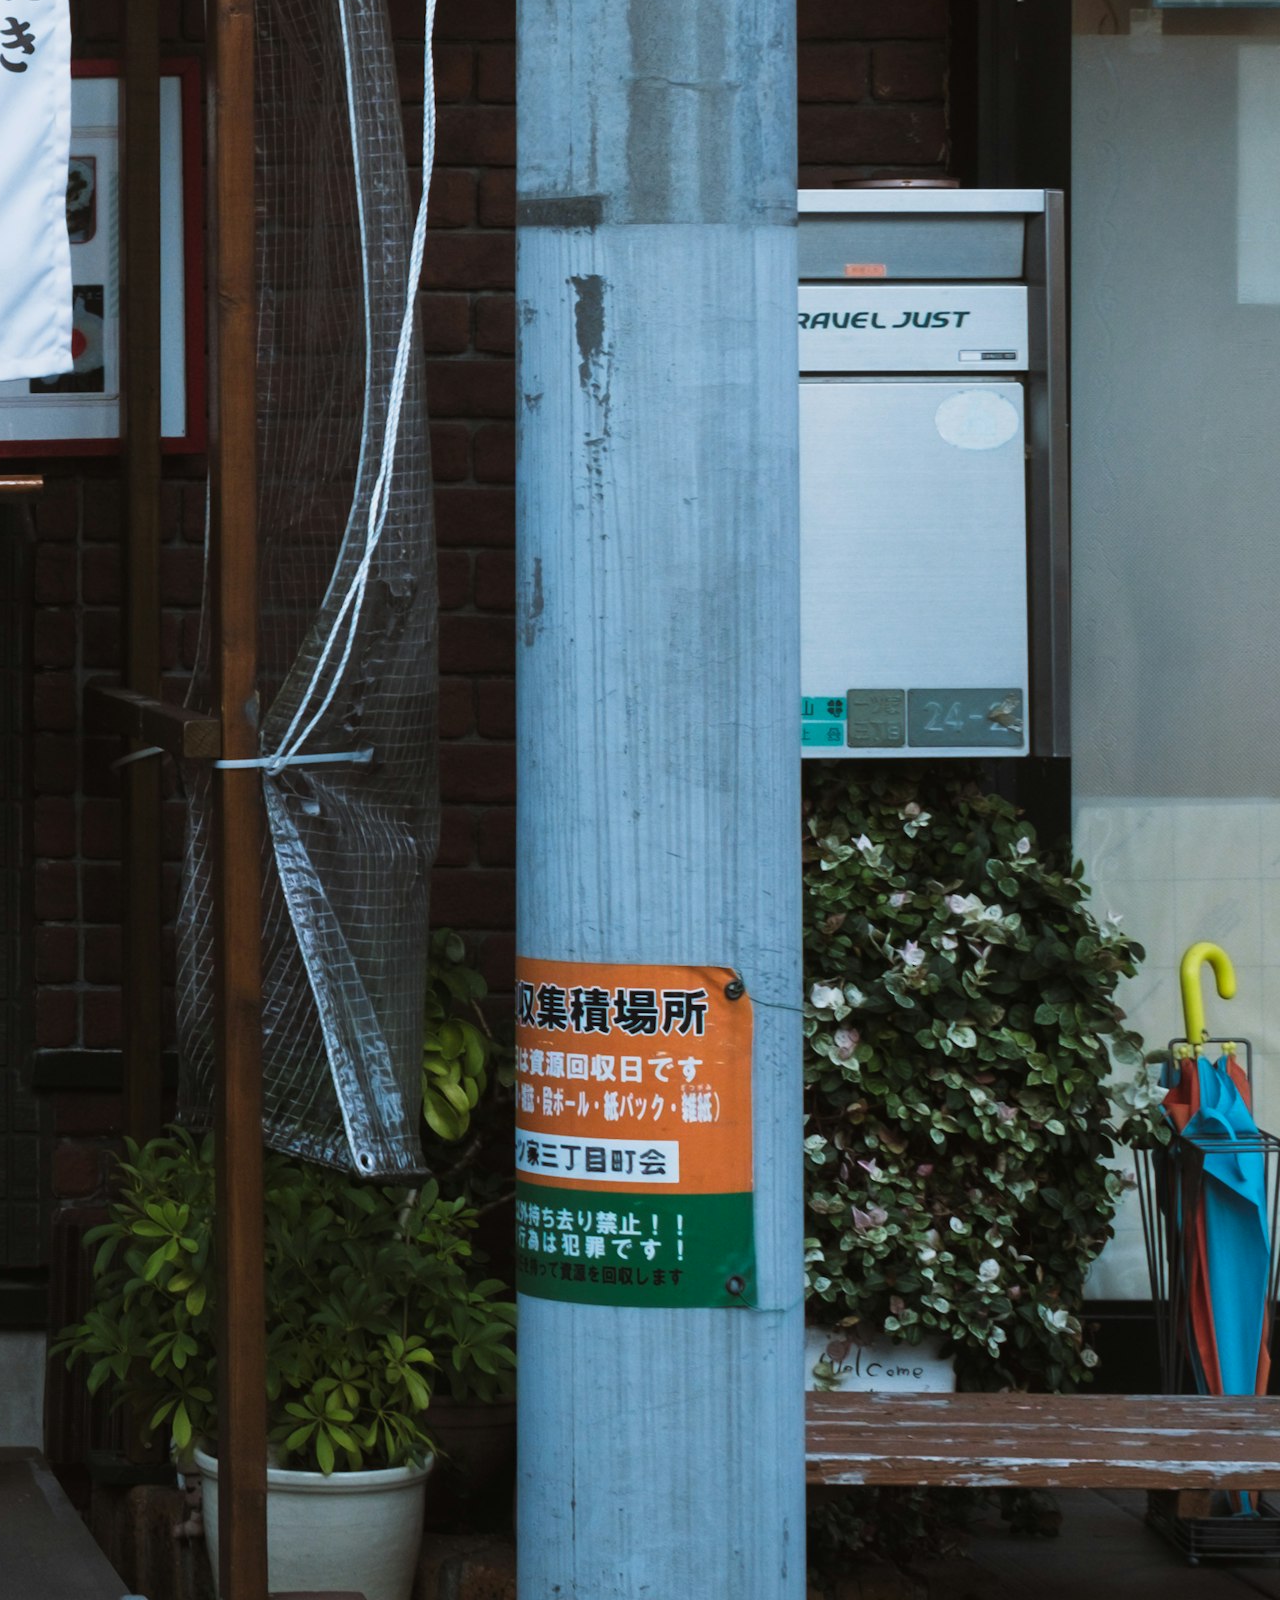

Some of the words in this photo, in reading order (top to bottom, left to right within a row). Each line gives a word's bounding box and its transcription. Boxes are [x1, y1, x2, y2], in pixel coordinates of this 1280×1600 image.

[892, 312, 970, 328] JUST
[515, 1048, 703, 1083] は資源回収日です
[516, 1224, 683, 1261] 行為は犯罪です！
